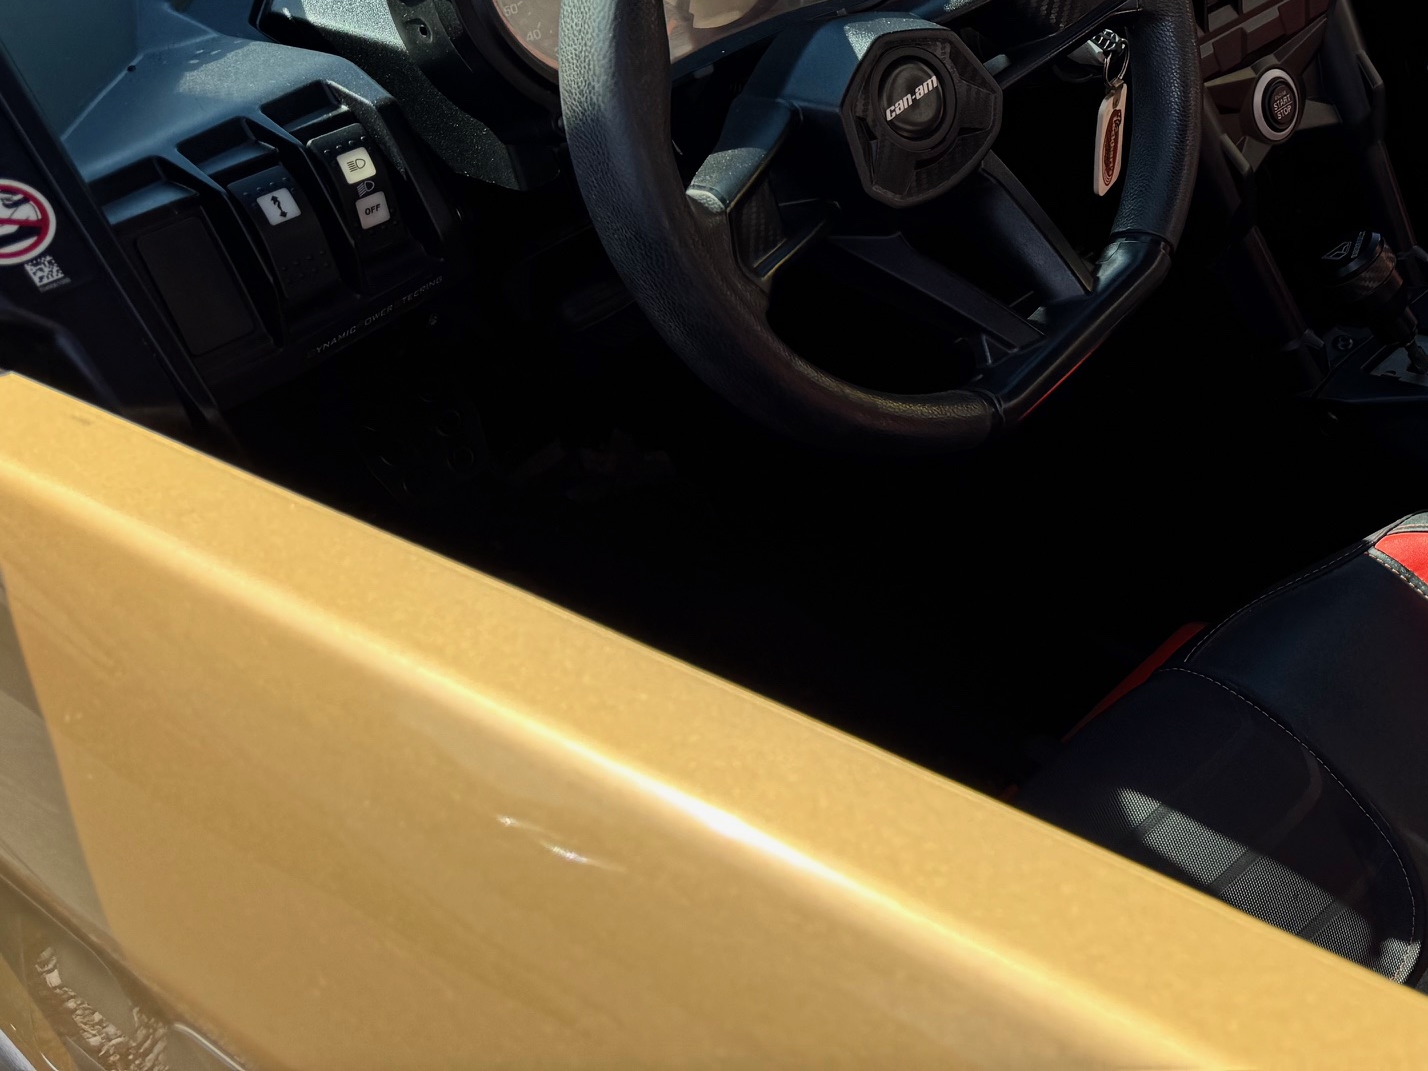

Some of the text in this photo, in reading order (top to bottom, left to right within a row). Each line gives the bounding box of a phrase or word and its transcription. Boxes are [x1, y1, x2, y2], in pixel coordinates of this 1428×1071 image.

[503, 3, 518, 17] 50
[526, 29, 542, 42] 40
[886, 75, 938, 121] can-am
[1273, 94, 1290, 110] START
[1277, 105, 1291, 119] STOP
[365, 203, 381, 215] OFF
[306, 275, 443, 358] YNAMIC OWER TEERING
